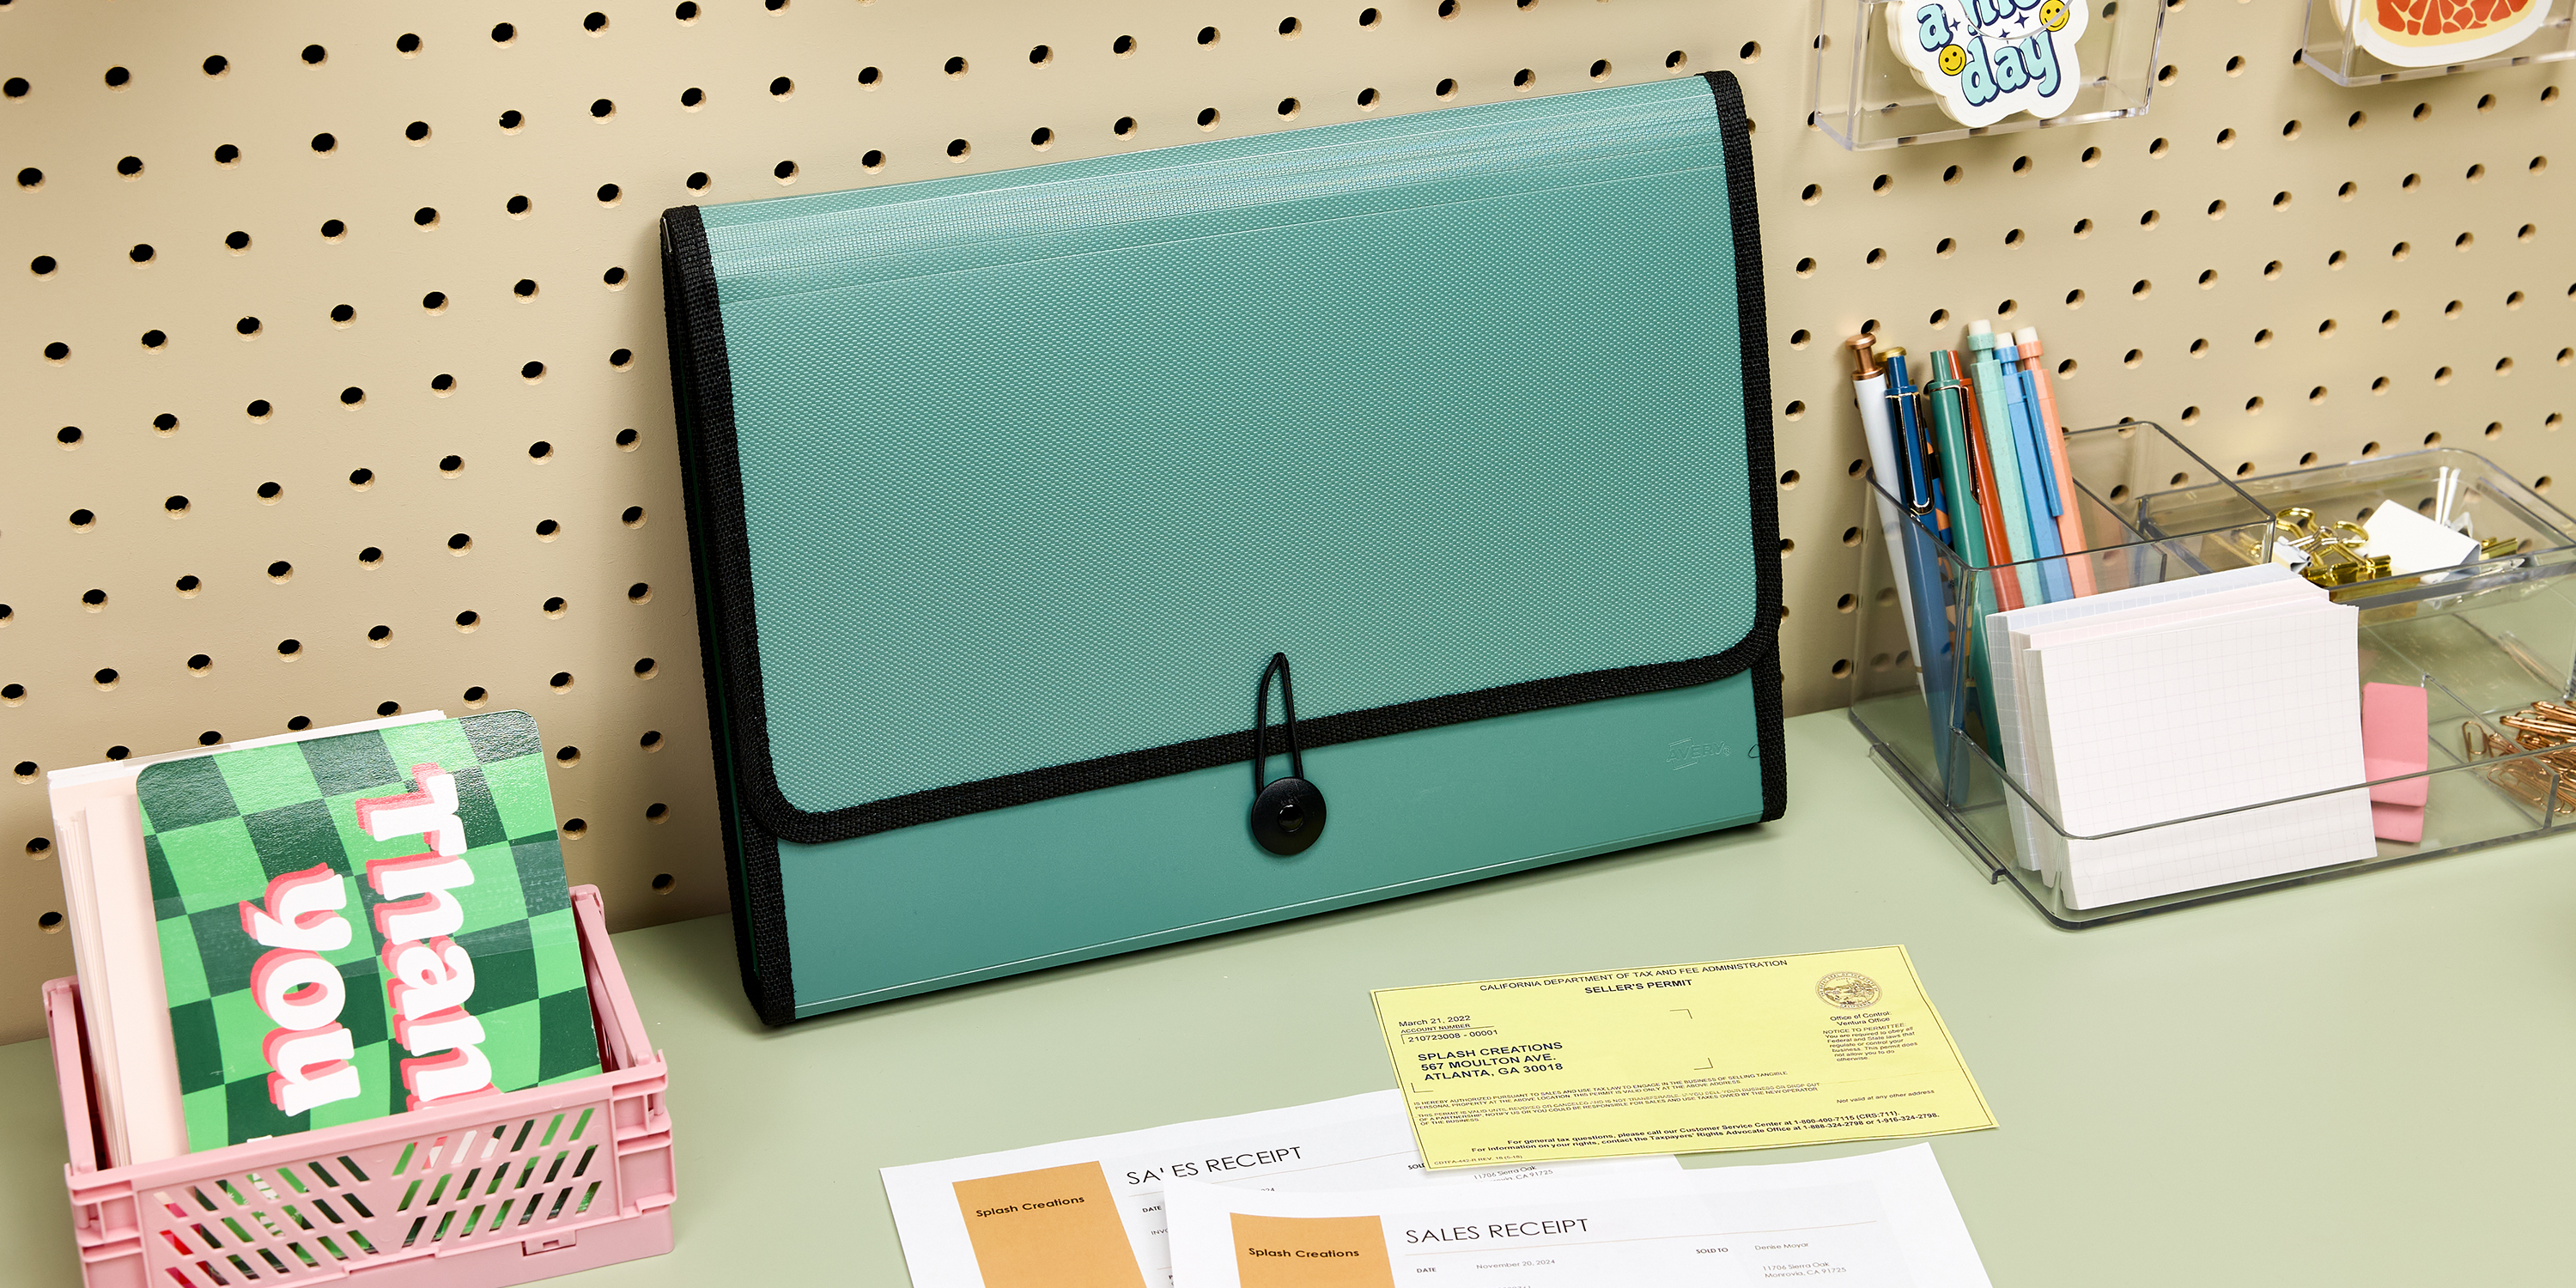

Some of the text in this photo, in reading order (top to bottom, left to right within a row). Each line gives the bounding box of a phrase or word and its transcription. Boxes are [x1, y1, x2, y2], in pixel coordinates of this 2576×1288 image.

[1917, 3, 1953, 52] a
[1961, 30, 2061, 106] day
[355, 762, 495, 1111] Than
[1480, 981, 1541, 991] CALIFORNIA
[1544, 974, 1613, 986] DEPARTMENT
[1703, 960, 1787, 972] ADMINISTRATION
[1585, 979, 1692, 993] SELLER'S PERMIT
[239, 862, 361, 1116] you
[1408, 1032, 1461, 1042] 210723008
[1419, 1042, 1563, 1061] SPLASH CREATIONS
[1421, 1053, 1556, 1071] 567 MOULTON AVE.
[1425, 1062, 1563, 1081] ATLANTA, GA 30018
[1205, 1146, 1301, 1172] RECEIPT
[1473, 1171, 1497, 1180] 11706
[1497, 1168, 1519, 1176] Sierra
[975, 1197, 1084, 1218] Splash Creations
[1406, 1218, 1588, 1243] SALES RECEIPT
[1249, 1248, 1291, 1257] Splash
